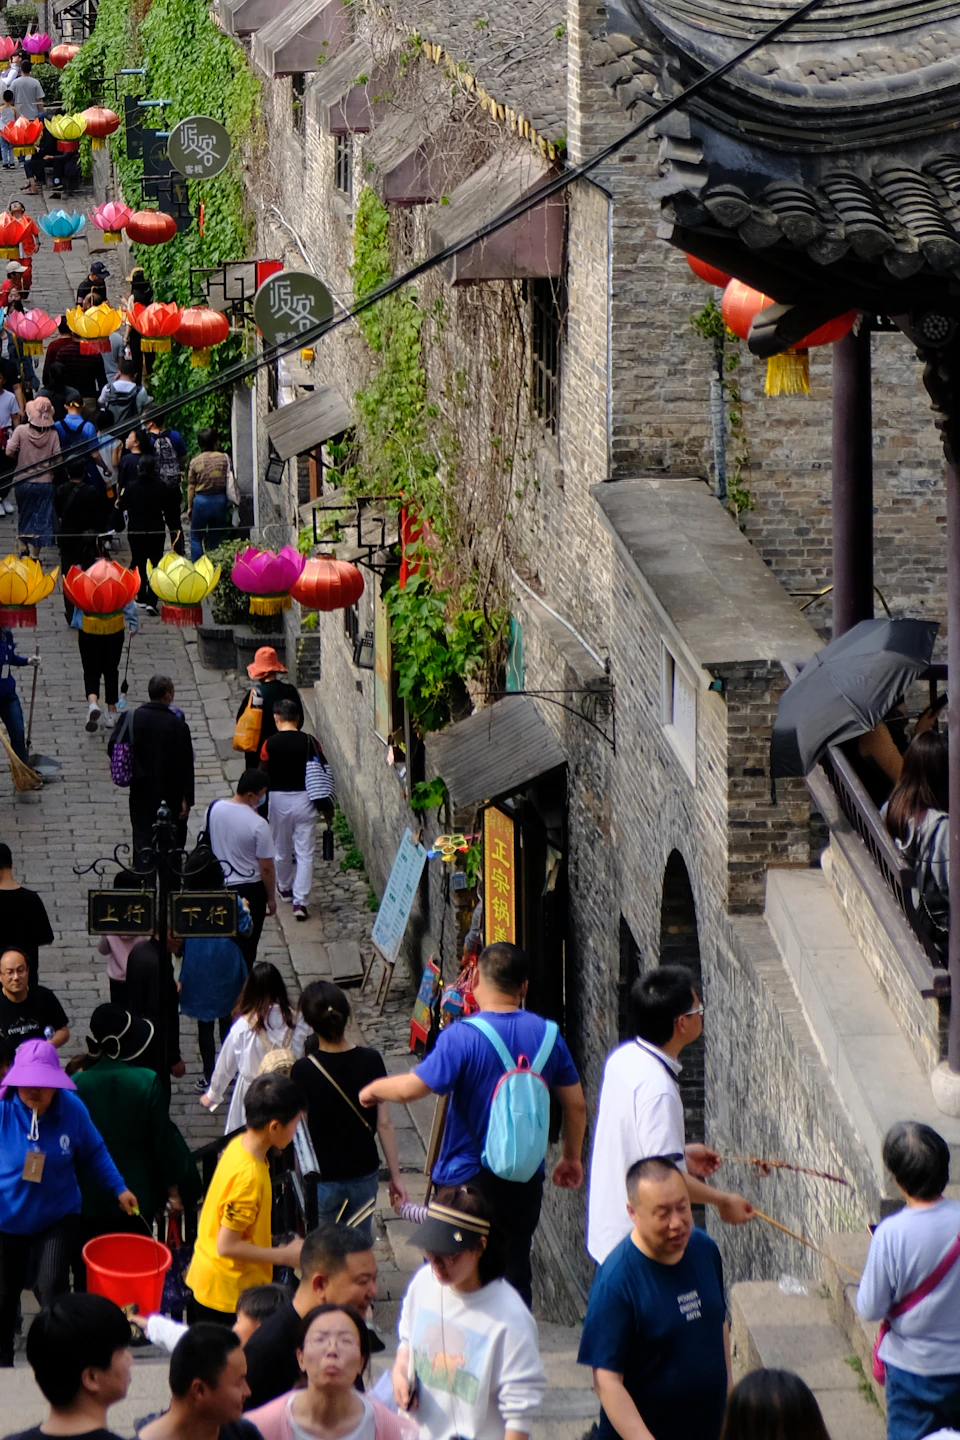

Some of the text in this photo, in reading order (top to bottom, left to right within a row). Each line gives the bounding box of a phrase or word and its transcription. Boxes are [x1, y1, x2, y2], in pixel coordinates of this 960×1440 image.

[185, 164, 203, 175] 客栈
[99, 904, 145, 924] 上行
[181, 905, 228, 926] 下行
